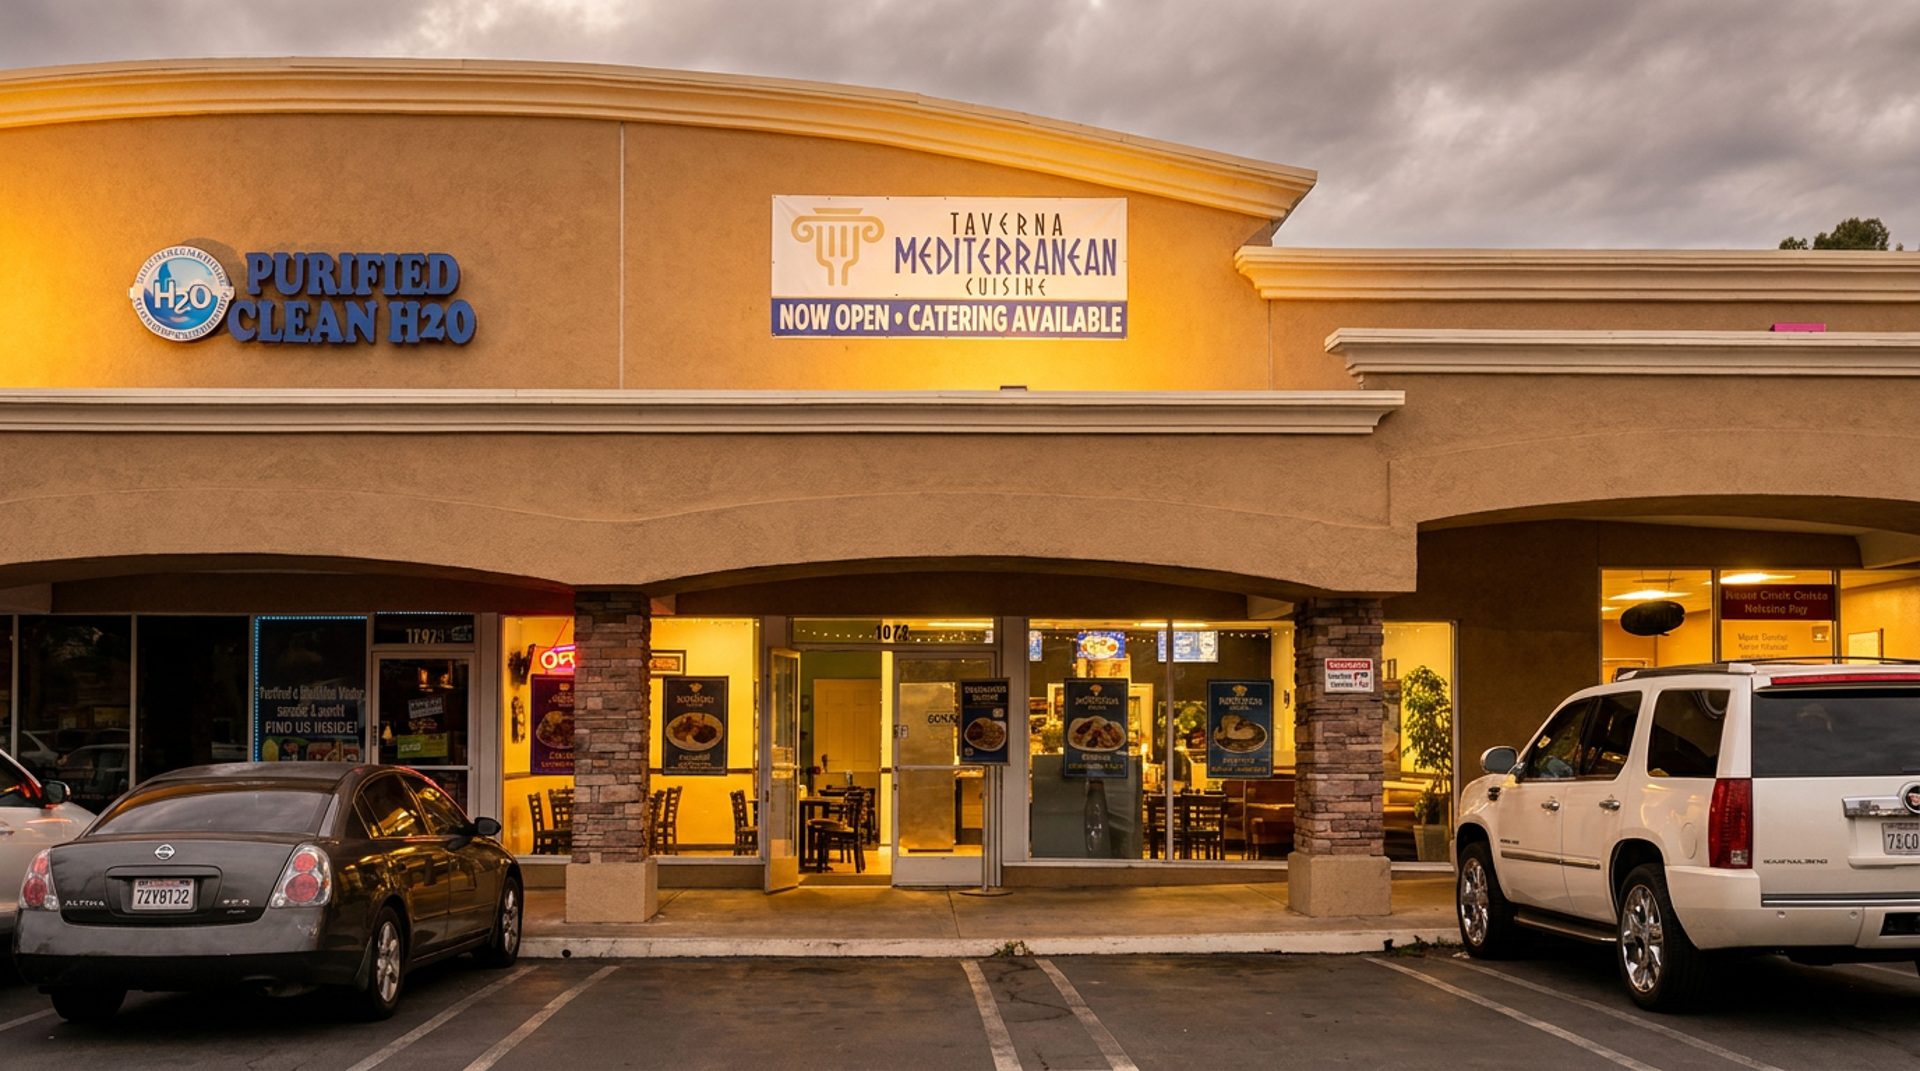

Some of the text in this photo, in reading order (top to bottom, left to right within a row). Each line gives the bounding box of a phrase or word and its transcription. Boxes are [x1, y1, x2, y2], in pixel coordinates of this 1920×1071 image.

[950, 212, 1063, 236] TAVERNA
[895, 236, 1117, 276] MEDITERRANEAN
[246, 252, 461, 296] PURIFIED
[153, 279, 213, 314] H2O
[227, 300, 378, 344] CLEAN
[779, 303, 1122, 333] NOW OPEN CATERING AVAILABLE
[295, 721, 311, 734] US
